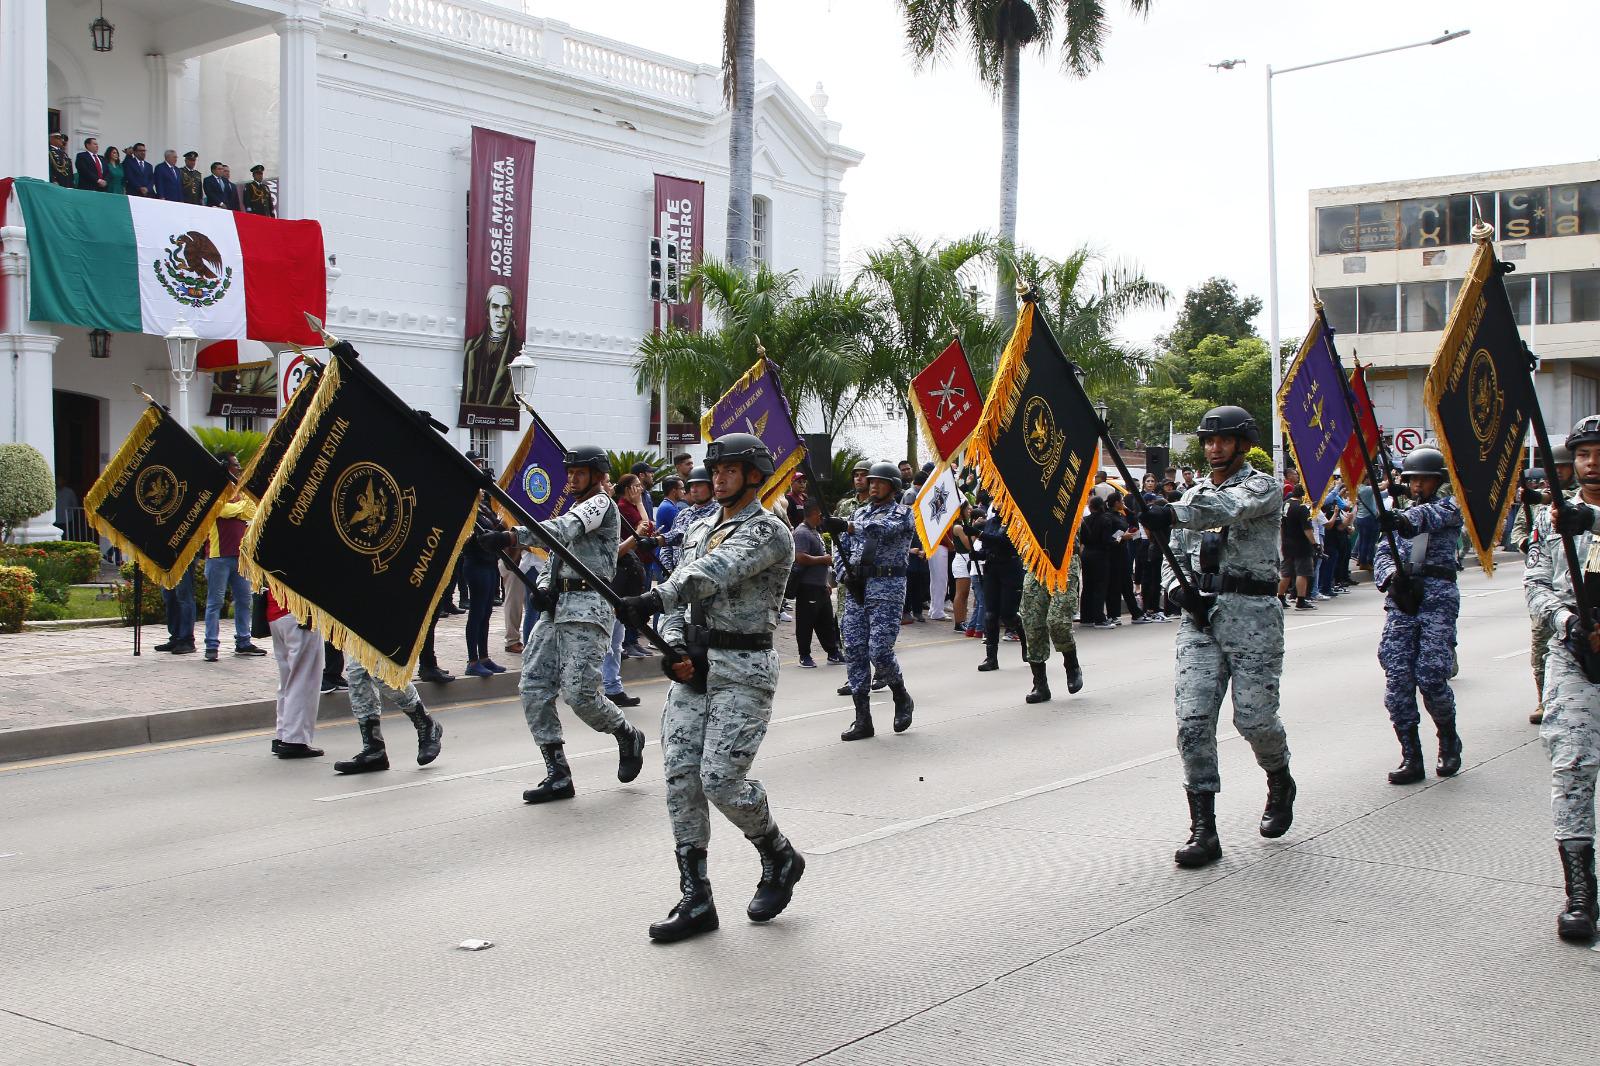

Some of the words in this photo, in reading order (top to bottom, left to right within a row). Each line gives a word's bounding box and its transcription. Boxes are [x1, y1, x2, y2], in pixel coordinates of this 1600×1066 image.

[490, 160, 505, 224] MARÍA
[503, 156, 515, 202] PAVÓN
[504, 203, 514, 212] Y
[489, 227, 503, 276] JOSÉ
[502, 215, 514, 277] MORELOS
[288, 454, 331, 526] COORDINACION
[321, 416, 350, 459] ESTATAL
[167, 520, 192, 550] TERCERA
[409, 526, 444, 588] SINALOA
